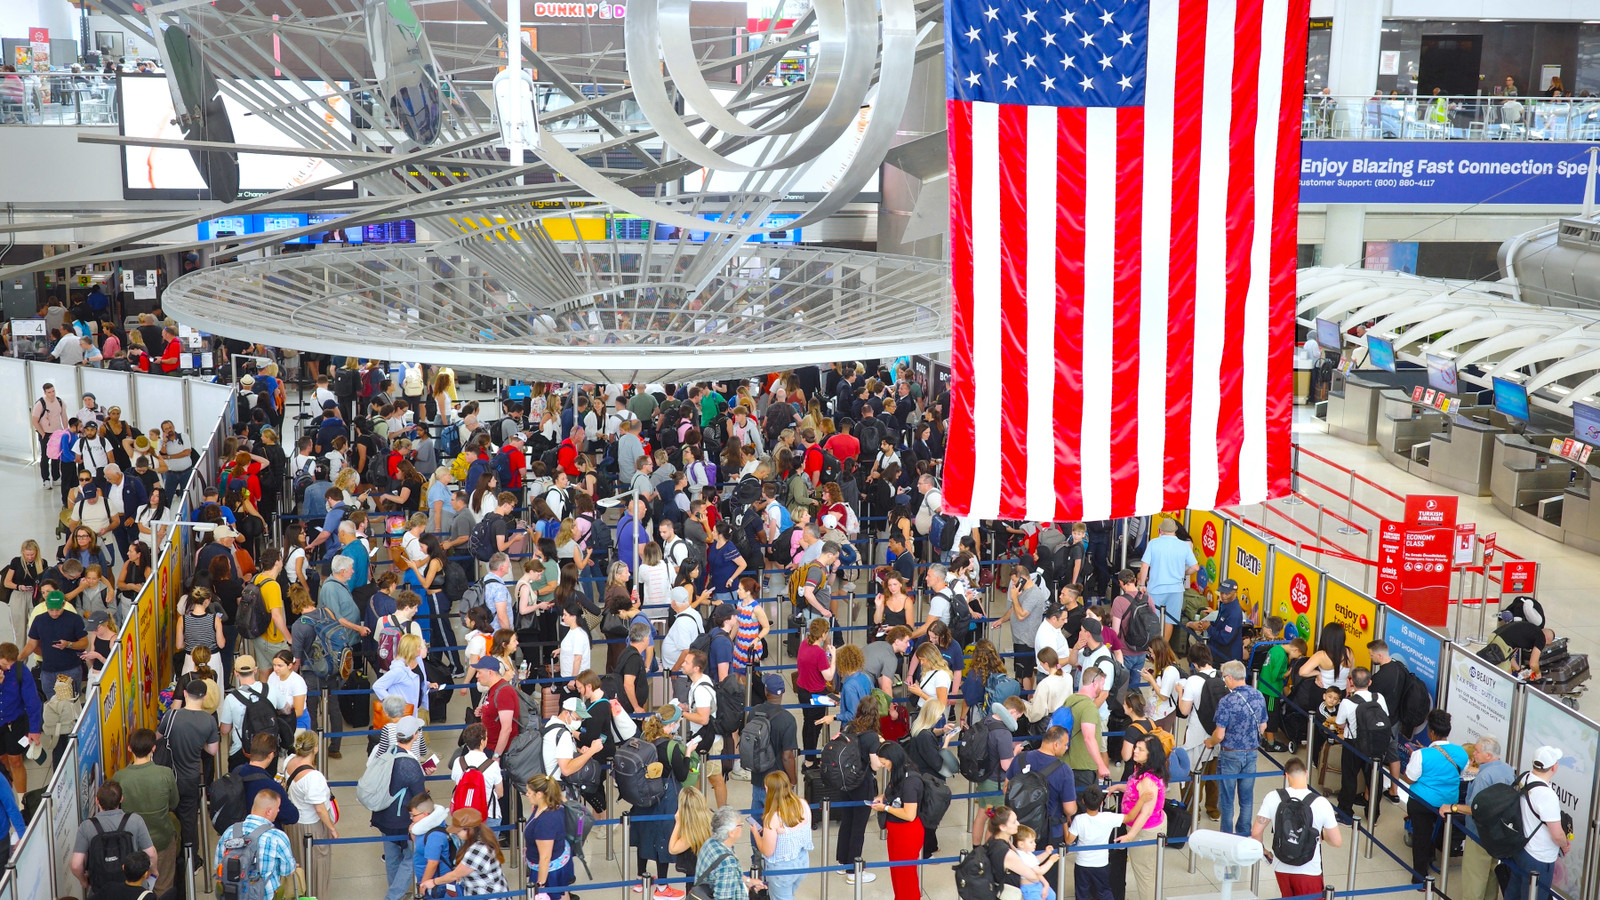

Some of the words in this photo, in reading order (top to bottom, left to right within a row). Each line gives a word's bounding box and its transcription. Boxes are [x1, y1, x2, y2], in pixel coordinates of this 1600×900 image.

[535, 3, 597, 16] DUNKIN'
[1301, 157, 1348, 177] Enjoy
[1352, 158, 1414, 178] Blazing
[1418, 159, 1454, 174] Fast
[1458, 159, 1553, 175] Connection
[1556, 160, 1600, 178] Spe
[1338, 179, 1372, 188] Support:
[1374, 179, 1397, 188] (800)
[1399, 179, 1435, 187] 880-4117
[81, 276, 88, 284] 3
[36, 323, 43, 333] 4
[940, 372, 951, 381] BO
[1203, 534, 1215, 551] $32
[1406, 533, 1435, 541] ECONOMY
[1291, 587, 1308, 607] $32
[1335, 603, 1358, 623] enjoy
[1334, 615, 1362, 639] toether
[1389, 635, 1401, 647] START
[1401, 643, 1423, 660] SHOPPING
[1423, 655, 1436, 667] NOW!
[1477, 670, 1496, 688] BEAUTY
[1457, 674, 1465, 685] TAX
[1466, 681, 1478, 692] FREE
[1481, 689, 1494, 700] DUTY
[1495, 698, 1507, 709] FREE
[1549, 781, 1579, 811] EAUTY
